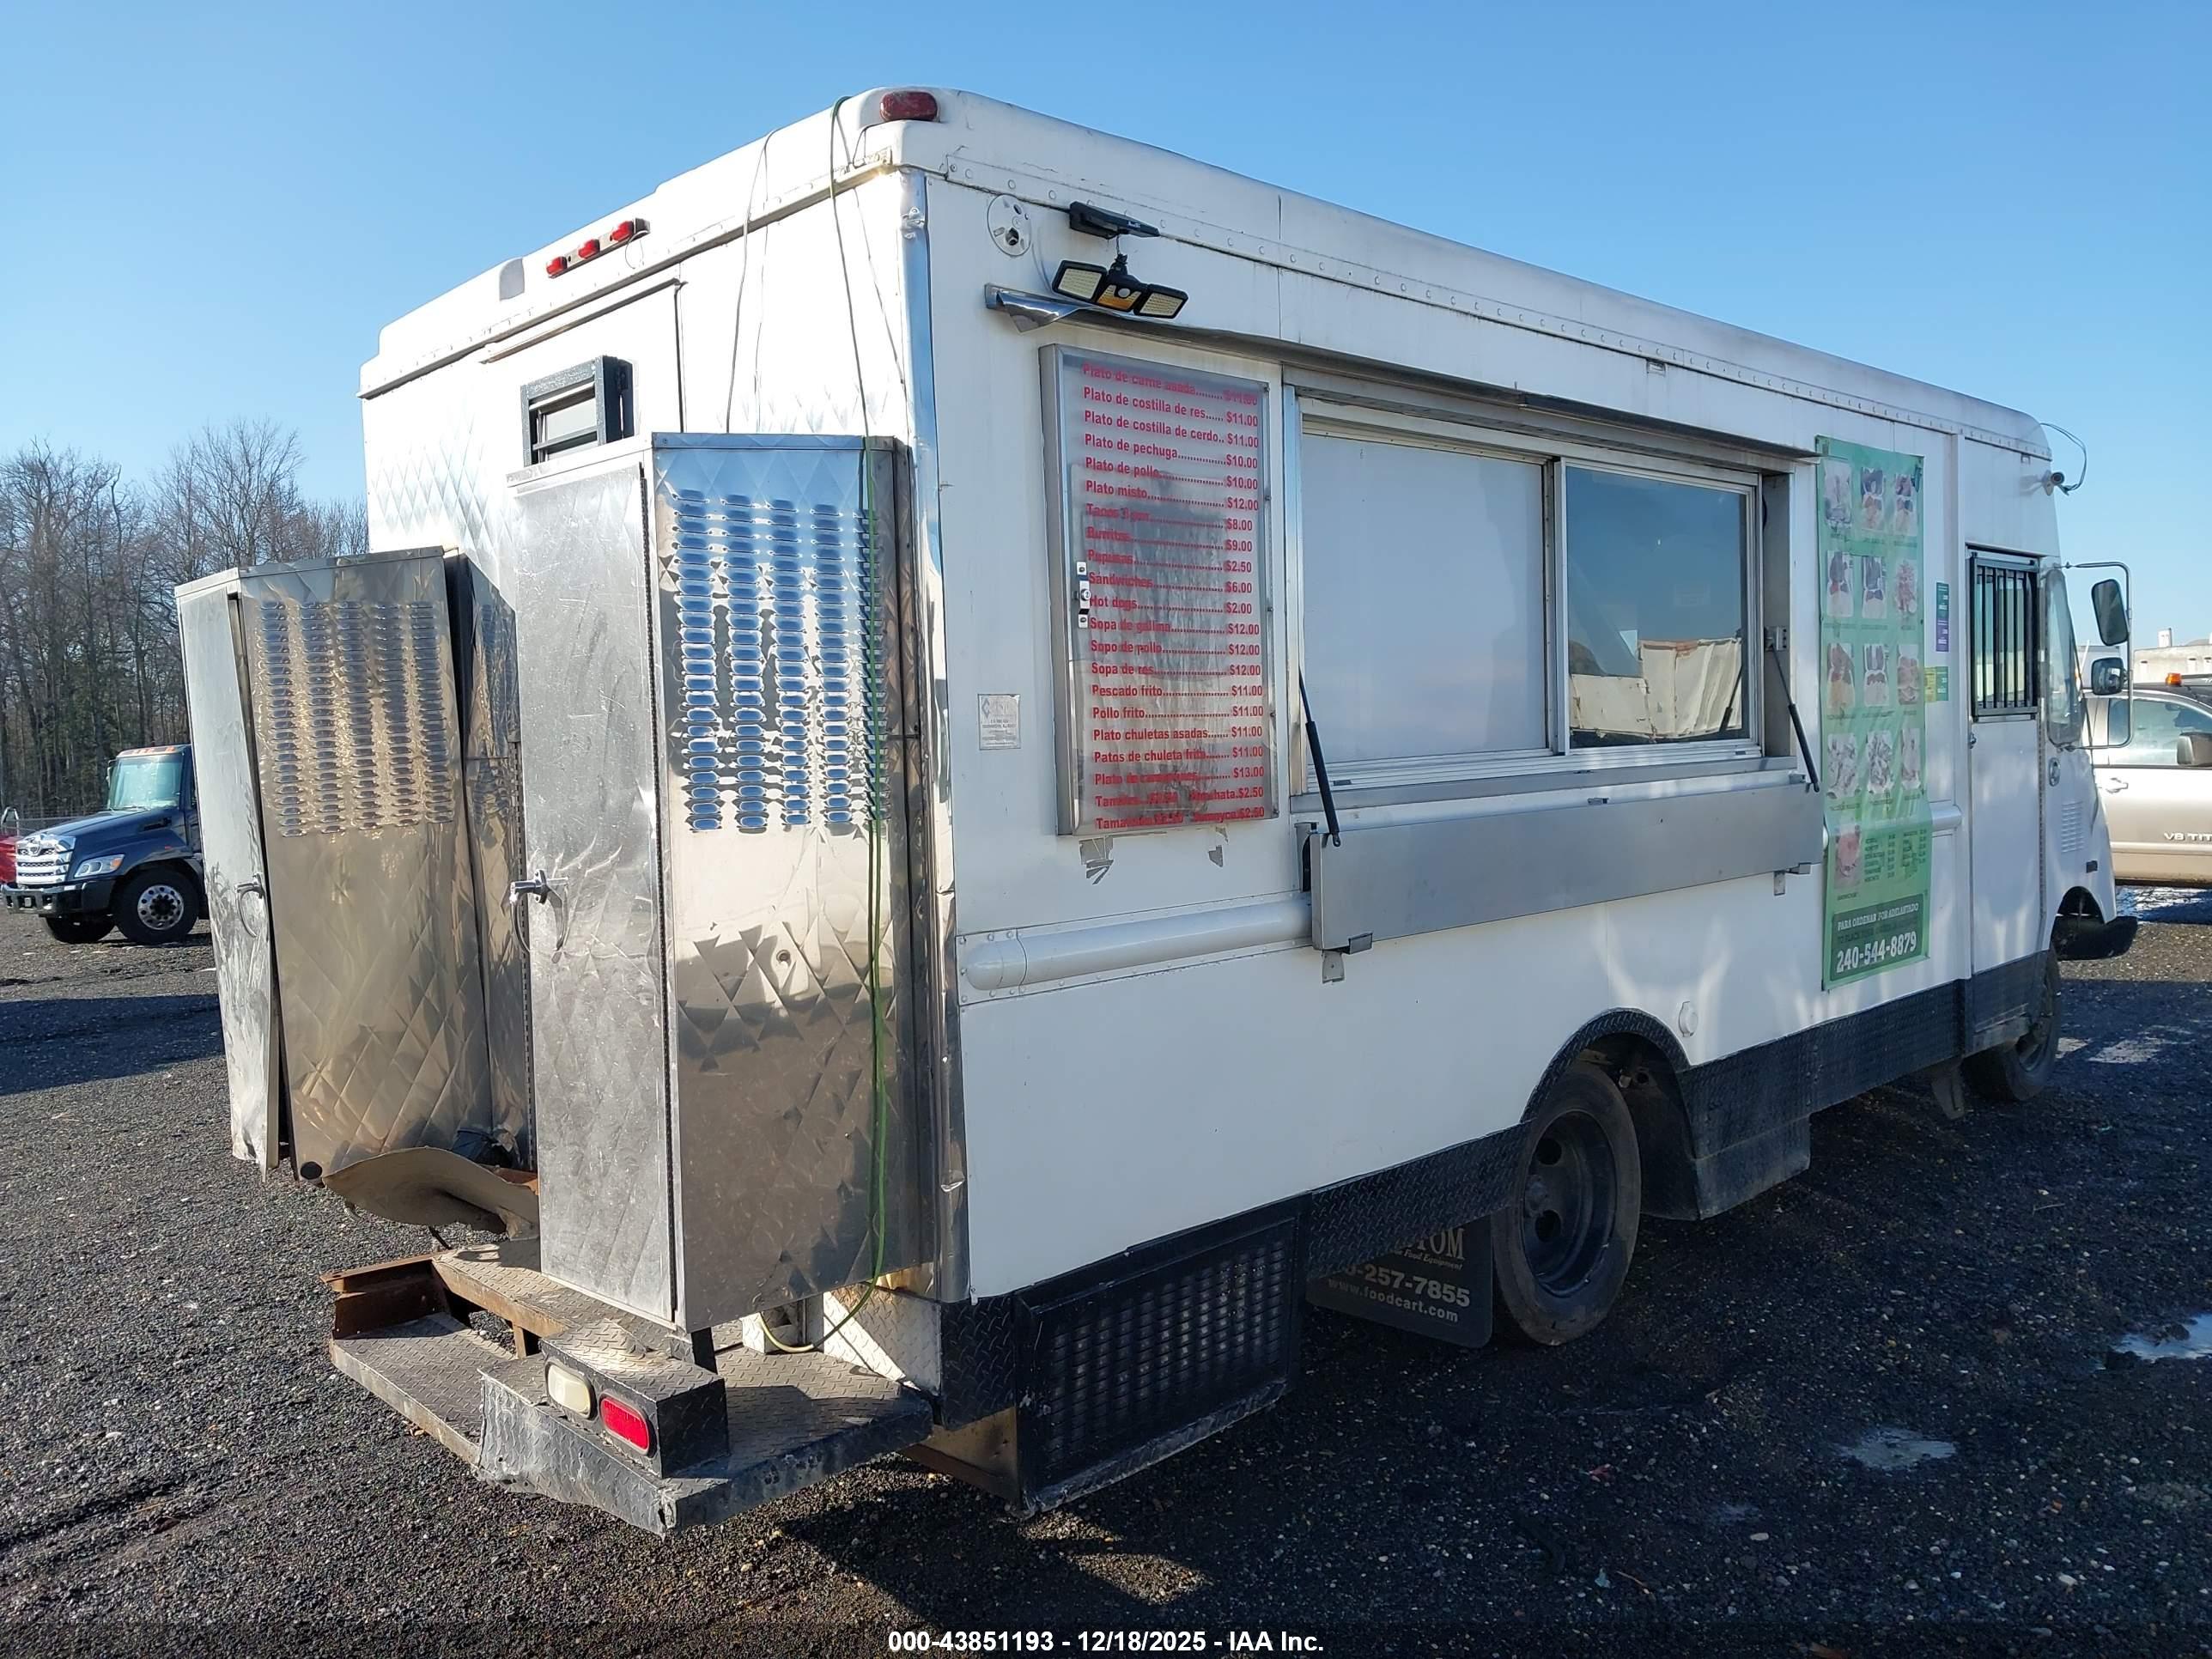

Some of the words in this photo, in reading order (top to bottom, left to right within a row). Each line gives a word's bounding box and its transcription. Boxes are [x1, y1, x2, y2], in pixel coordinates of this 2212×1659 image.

[1083, 362, 1111, 380] Plato
[1115, 370, 1128, 383] de
[1084, 387, 1112, 403] Plato
[1116, 392, 1129, 405] de
[1133, 397, 1171, 413] costilla
[1175, 404, 1187, 416] de
[1190, 407, 1206, 418] res
[1226, 411, 1258, 427] $11.00
[1085, 410, 1113, 426] Plato
[1116, 416, 1129, 428] de
[1133, 418, 1171, 434] costilla
[1175, 425, 1187, 437] de
[1190, 428, 1218, 442] cerdo
[1227, 433, 1259, 447] $11.00
[1085, 434, 1113, 448] Plato
[1117, 439, 1129, 451] de
[1133, 441, 1177, 459] pechuga
[1226, 454, 1258, 468] $10.00
[1085, 457, 1114, 471] Plato
[1117, 461, 1130, 474] de
[1133, 465, 1161, 478] pollo
[1226, 476, 1258, 490] $10.00
[1085, 480, 1114, 495] Plato
[1117, 484, 1147, 498] misto
[1227, 497, 1259, 511] $12.00
[1226, 519, 1253, 532] $8.00
[1225, 539, 1253, 552] $9.00
[1224, 561, 1252, 573] $2.50
[1225, 581, 1252, 593] $6.00
[1090, 598, 1109, 607] Hot
[1112, 599, 1137, 611] dogs
[1224, 602, 1252, 614] $2.00
[1090, 617, 1116, 632] Sopa
[1120, 619, 1133, 630] de
[1228, 623, 1260, 635] $12.00
[1121, 641, 1133, 652] de
[1228, 644, 1261, 656] $12.00
[1091, 663, 1118, 676] Sopa
[1122, 663, 1134, 674] de
[1138, 665, 1154, 675] res
[1230, 665, 1261, 677] $12.00
[1091, 685, 1137, 696] Pescado
[1140, 685, 1163, 696] frito
[1231, 685, 1263, 696] $11.00
[1093, 707, 1119, 719] Pollo
[1122, 707, 1145, 719] frito
[1232, 706, 1264, 717] $11.00
[1094, 729, 1121, 740] Plato
[1125, 728, 1170, 740] chuletas
[1173, 728, 1208, 738] asadas
[1231, 726, 1262, 738] $11.00
[1095, 751, 1124, 763] Patos
[1128, 750, 1140, 762] de
[1145, 749, 1182, 761] chuleta
[1232, 746, 1263, 757] $11.00
[1095, 774, 1122, 785] Plato
[1233, 767, 1264, 779] $13.00
[1237, 787, 1264, 799] $2.50
[2164, 832, 2185, 841] V8
[2188, 833, 2212, 842] TIT
[1837, 920, 1851, 932] PARA
[1852, 913, 1877, 927] ORDENAR
[1877, 910, 1888, 922] POR
[1836, 931, 1917, 974] 240-544-8879
[1404, 1248, 1423, 1262] Food
[1328, 1278, 1459, 1323] www.foodcart.com
